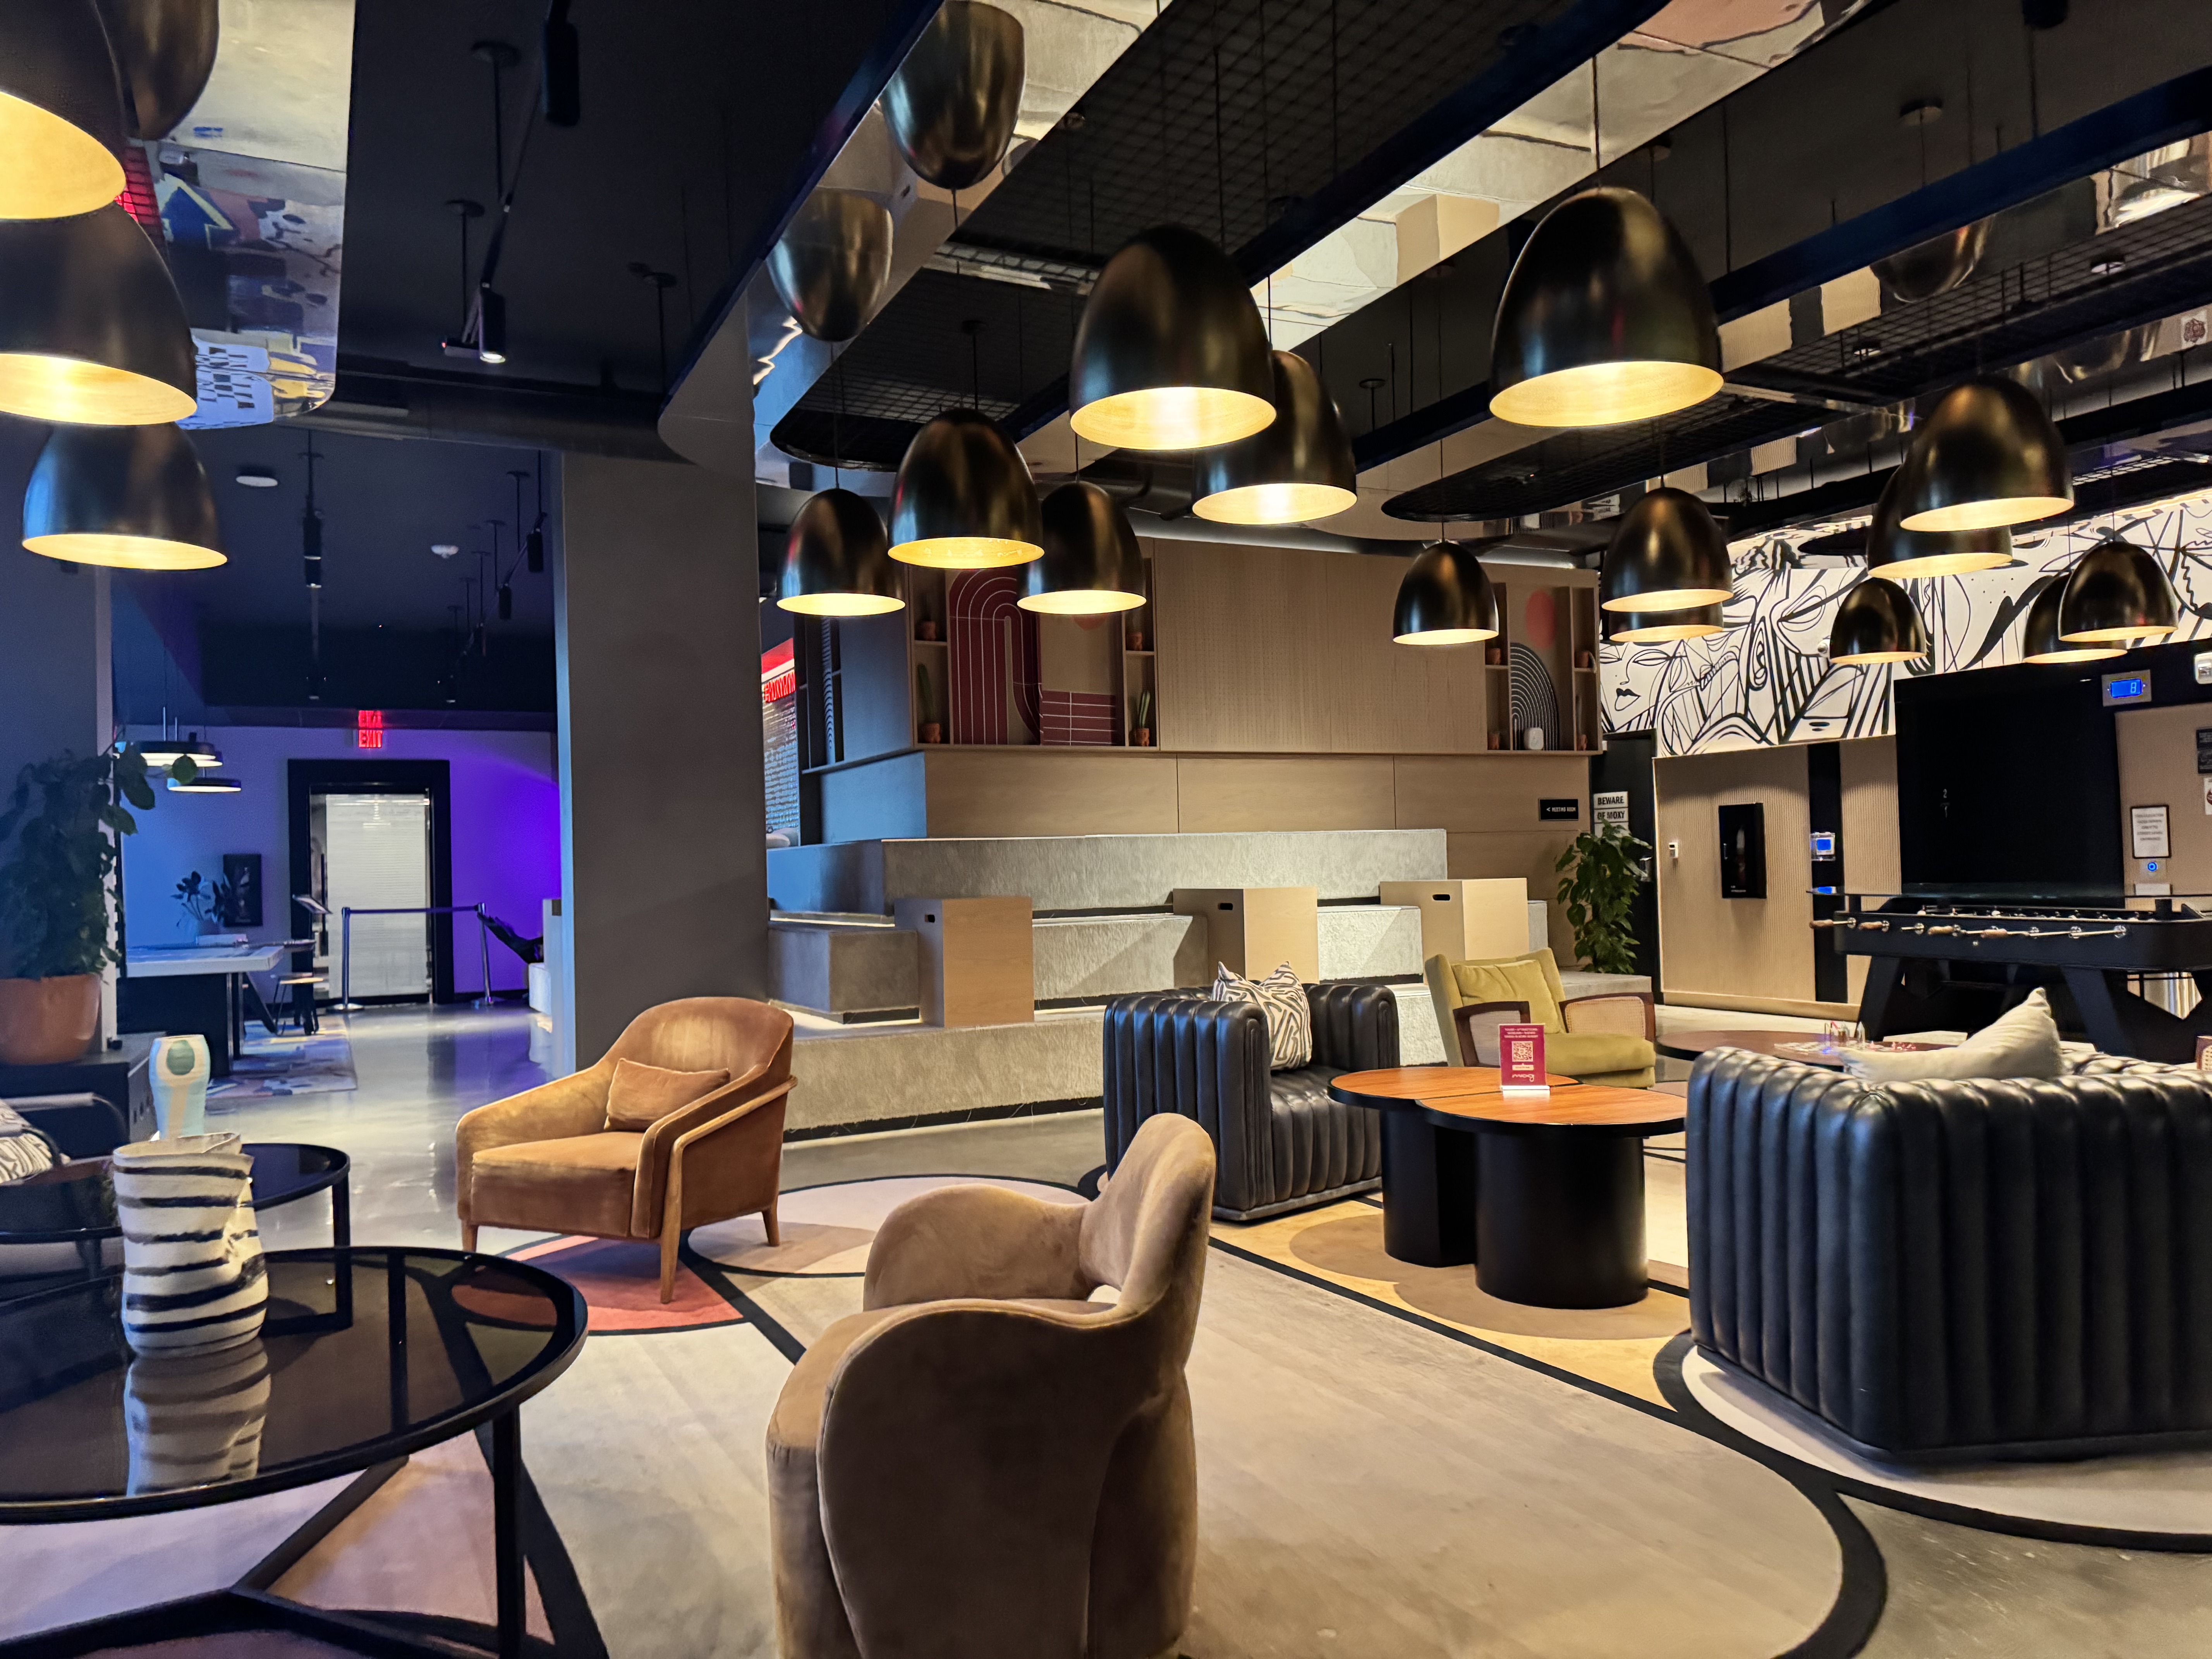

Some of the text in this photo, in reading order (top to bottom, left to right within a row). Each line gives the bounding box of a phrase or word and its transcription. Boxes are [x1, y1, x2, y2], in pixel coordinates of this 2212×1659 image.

[2130, 682, 2136, 693] 8
[359, 730, 383, 748] EXIT
[1598, 796, 1624, 805] BEWARE
